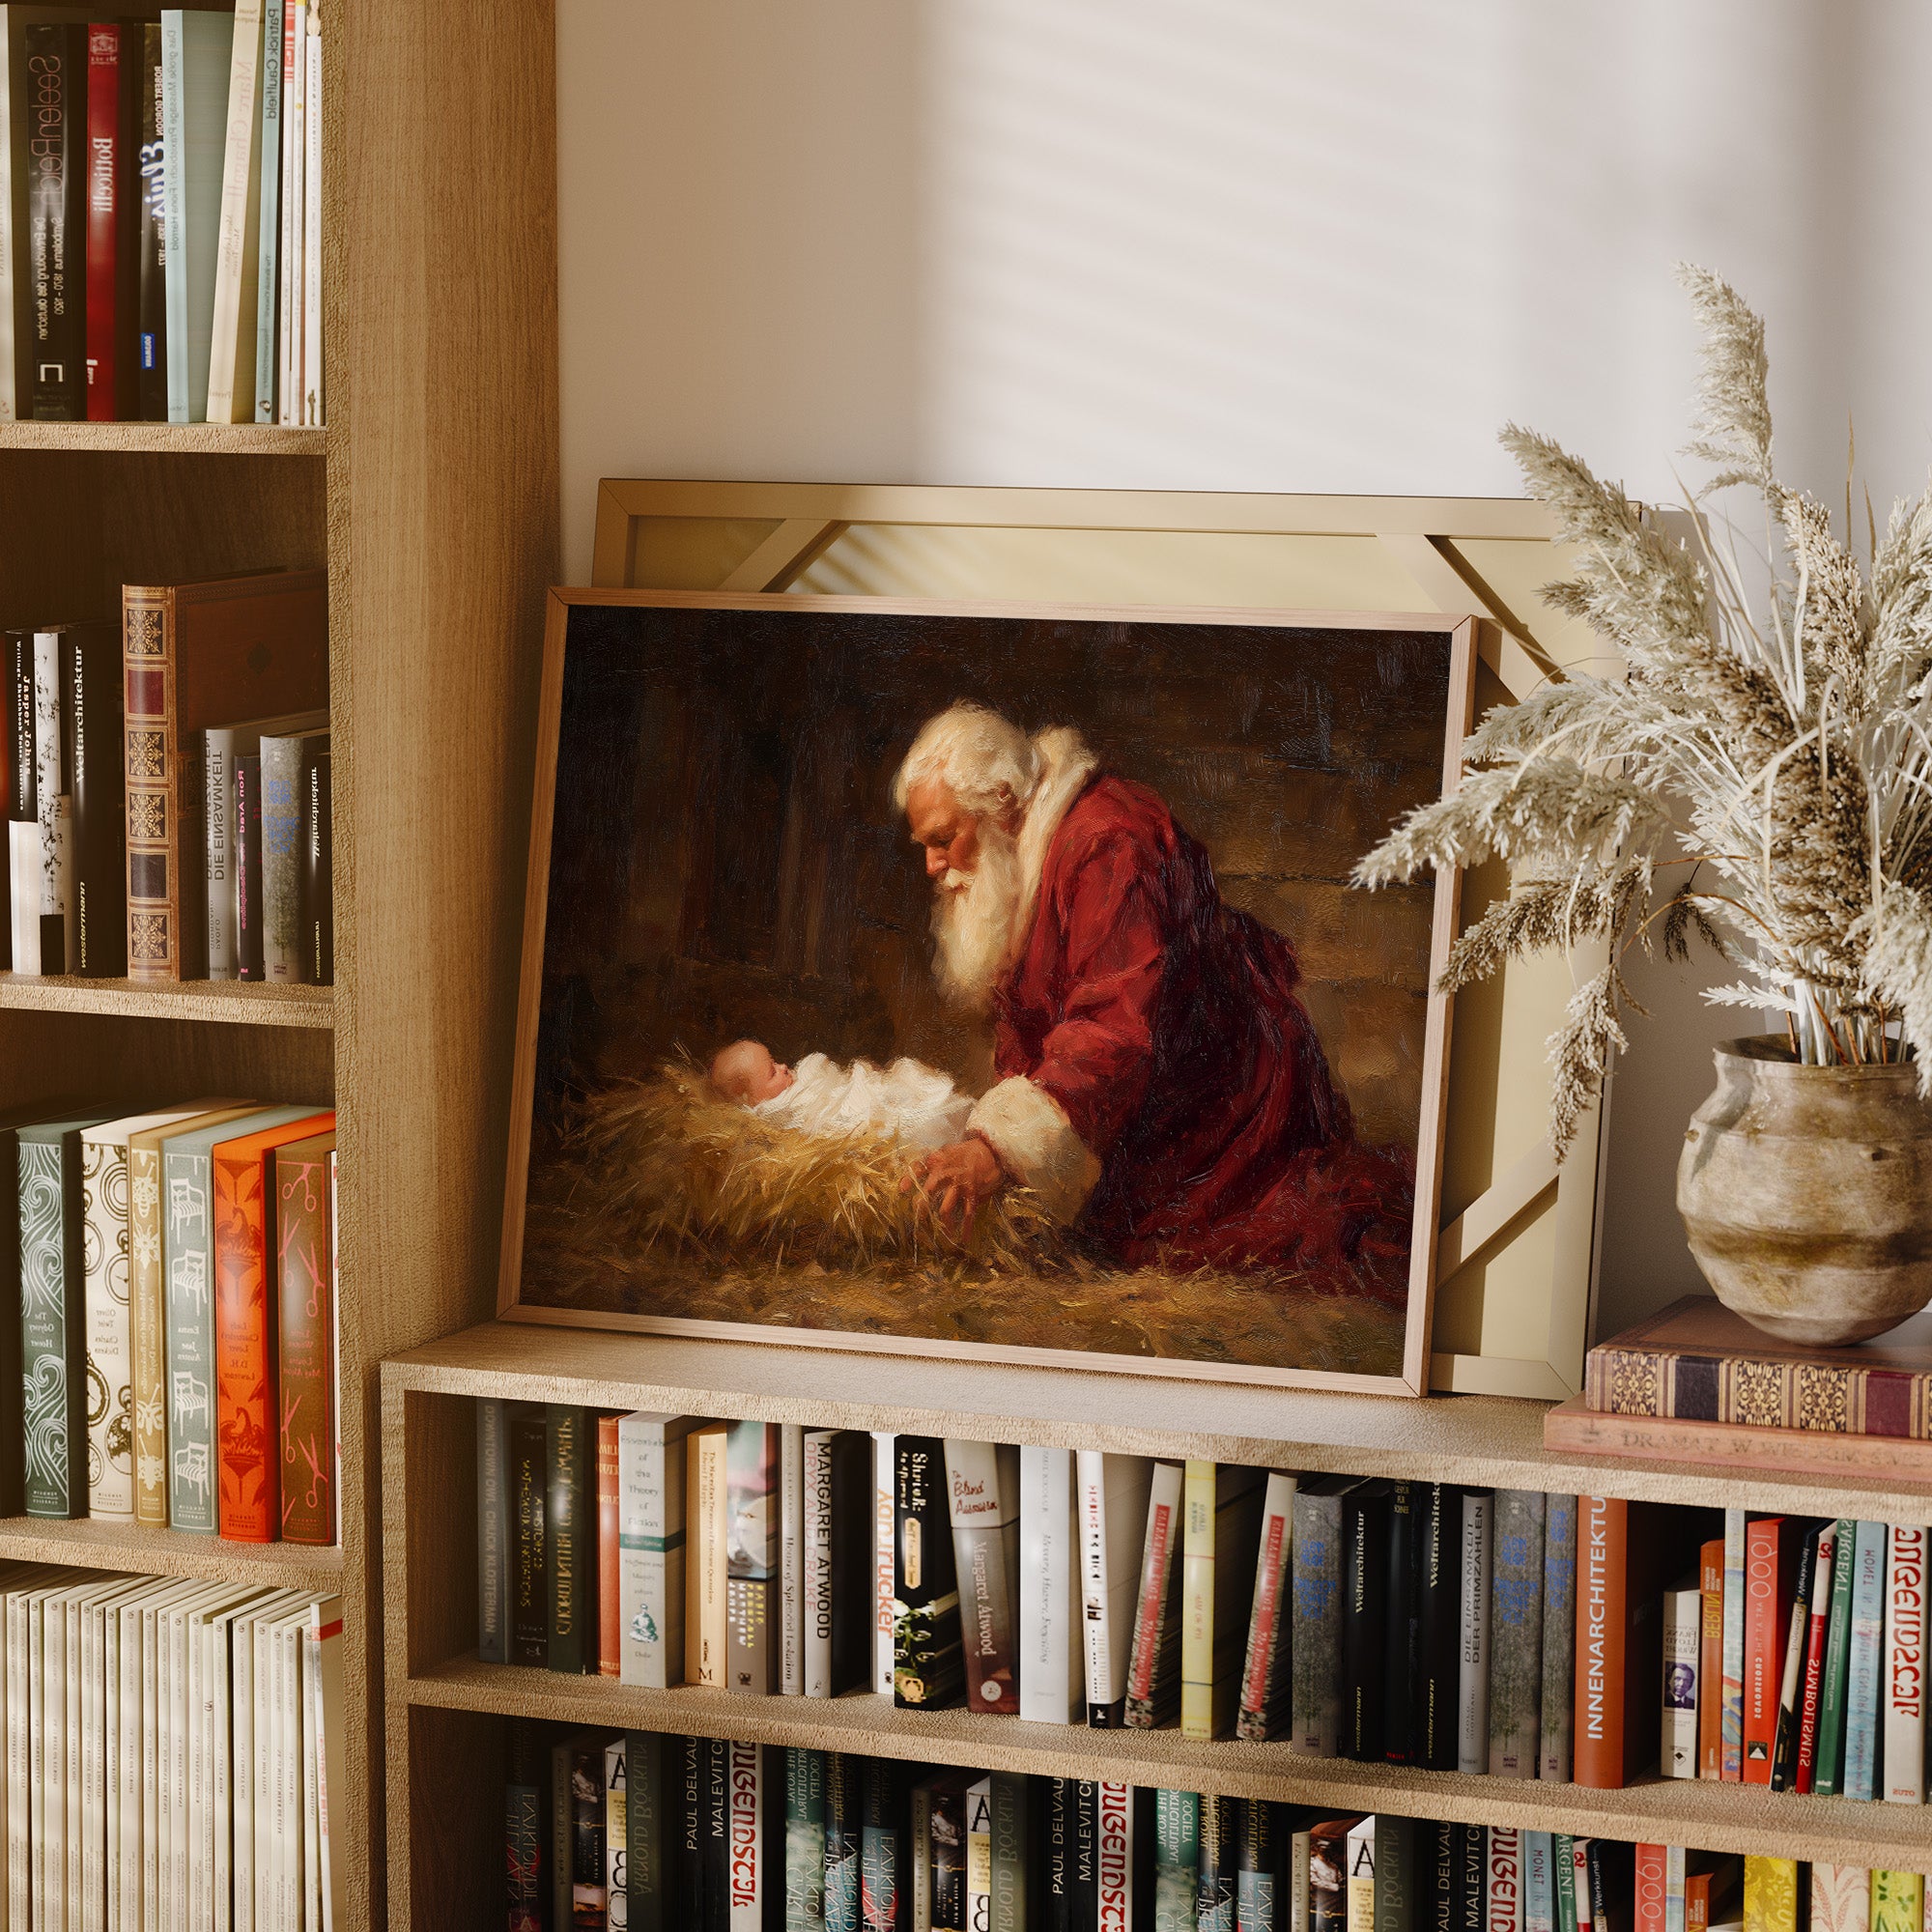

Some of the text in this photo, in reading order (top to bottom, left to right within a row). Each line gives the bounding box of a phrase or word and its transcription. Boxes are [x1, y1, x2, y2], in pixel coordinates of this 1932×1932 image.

[22, 675, 31, 726] Jasper
[73, 645, 84, 783] Weltarchitektur
[485, 1405, 497, 1634] DOWNTOWN OWL CHUCK KLOSTERMAN
[806, 1441, 818, 1612] ORYX AND CRAKE
[817, 1442, 830, 1639] MARGARET ATWOOD
[1355, 1511, 1365, 1614] Weltarchitektur
[1430, 1483, 1440, 1589] Weltarchitek
[972, 1541, 997, 1656] Margaret Atwood
[1464, 1520, 1473, 1663] DIE EINSAMKEIT
[1472, 1506, 1483, 1663] DER PRIMZAHLEN
[1587, 1496, 1606, 1740] INNENARCHITEKTU
[687, 1736, 697, 1851] PAUL DELVAU
[1052, 1777, 1064, 1894] PAUL DELVAU
[1438, 1821, 1450, 1890] DELVAU
[1533, 1849, 1544, 1885] MONET
[1558, 1833, 1574, 1897] ARGENT
[1593, 1861, 1602, 1907] Werkkunst
[1637, 1857, 1662, 1918] 1900
